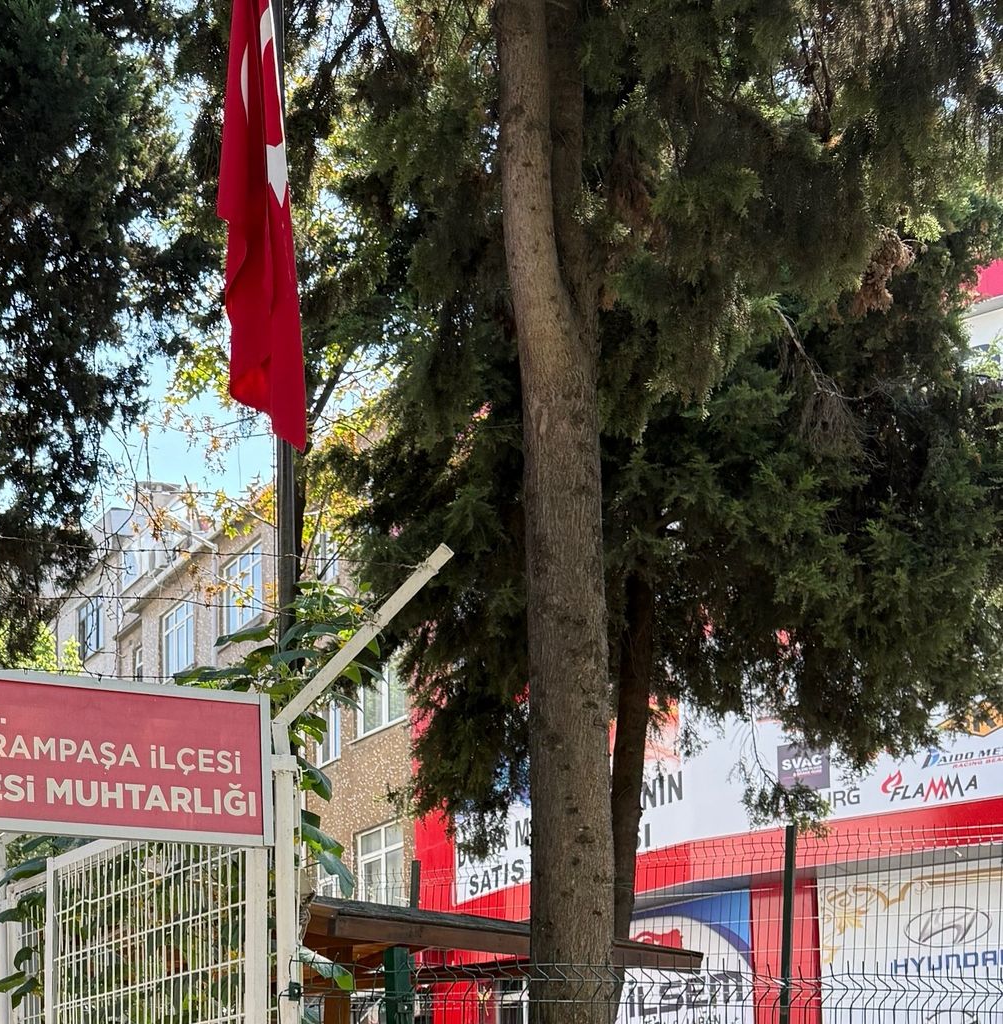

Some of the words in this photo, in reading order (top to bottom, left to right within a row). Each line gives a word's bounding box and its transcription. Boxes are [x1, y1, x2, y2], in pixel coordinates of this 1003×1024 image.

[781, 754, 823, 771] SVAC
[46, 778, 257, 818] MUHTARLIĞI
[890, 773, 978, 802] FLAMMA
